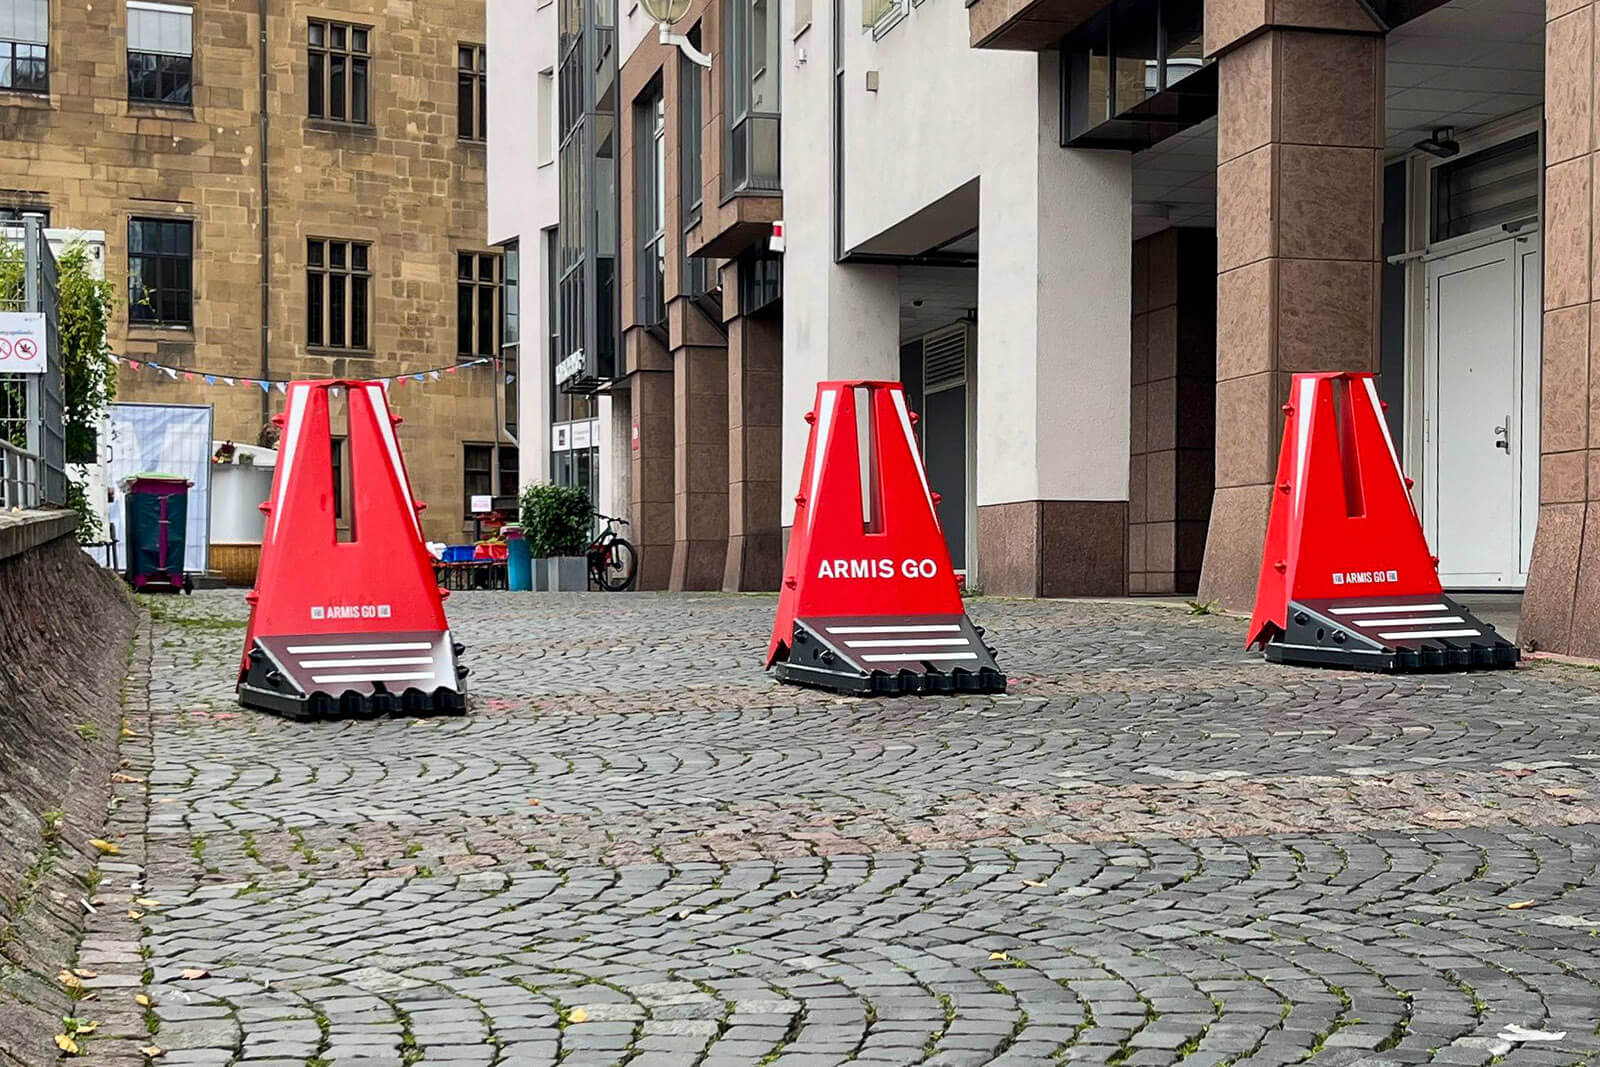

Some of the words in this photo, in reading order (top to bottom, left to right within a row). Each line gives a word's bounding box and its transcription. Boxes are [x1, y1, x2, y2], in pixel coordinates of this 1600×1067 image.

[817, 559, 895, 578] ARMIS
[901, 558, 937, 578] GO
[1345, 571, 1373, 583] ARMIS
[1373, 570, 1386, 583] GO
[327, 606, 360, 618] ARMIS
[361, 605, 376, 618] GO
